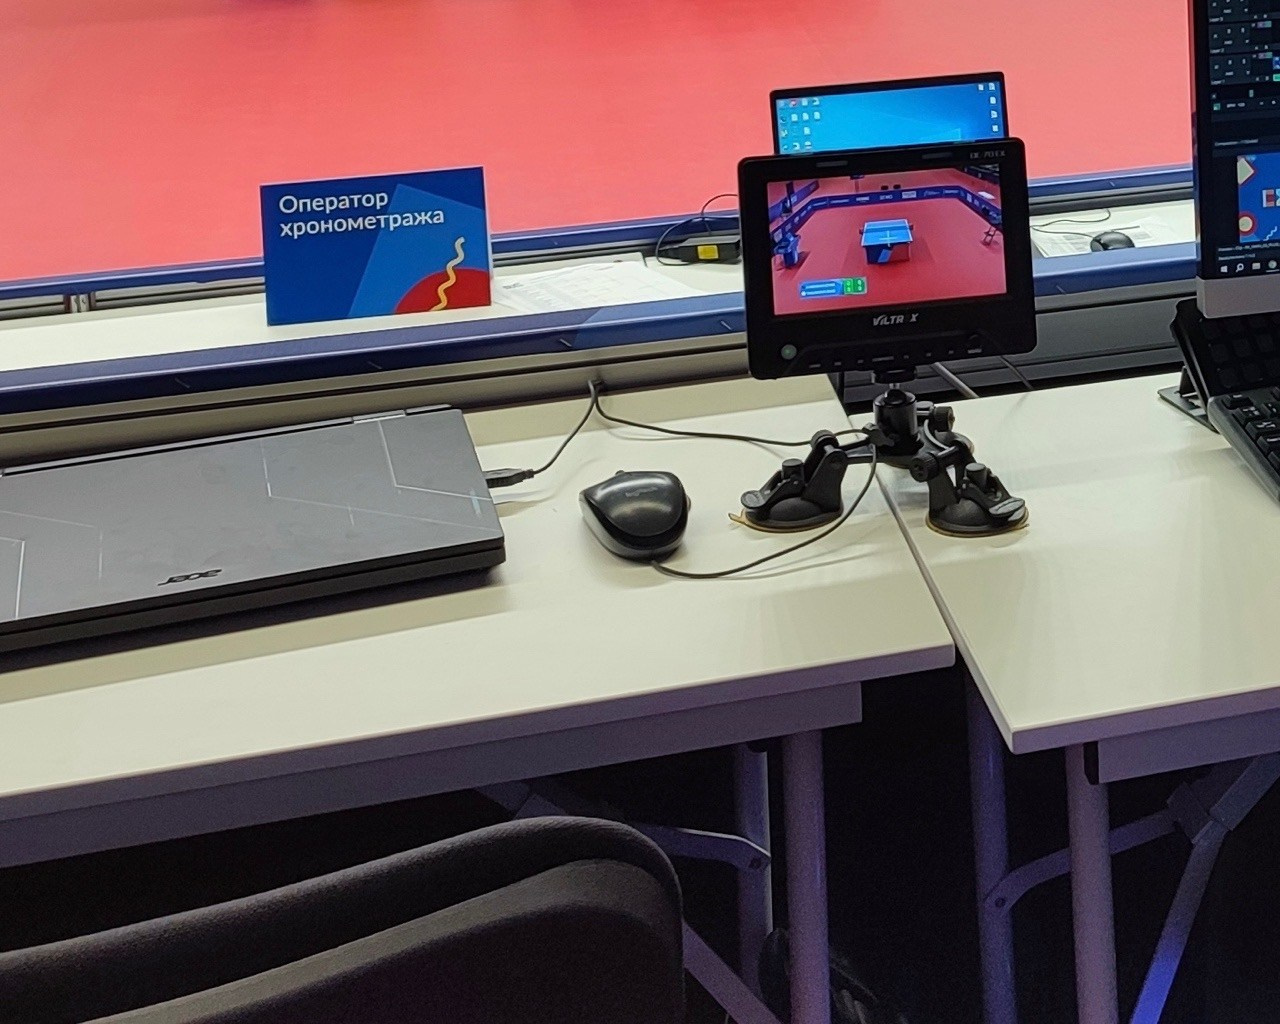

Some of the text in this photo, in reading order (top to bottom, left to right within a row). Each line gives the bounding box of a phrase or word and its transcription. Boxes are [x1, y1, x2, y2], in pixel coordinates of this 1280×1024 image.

[279, 192, 388, 213] Оператор
[280, 209, 444, 239] хронометража
[872, 313, 919, 326] VILTRX
